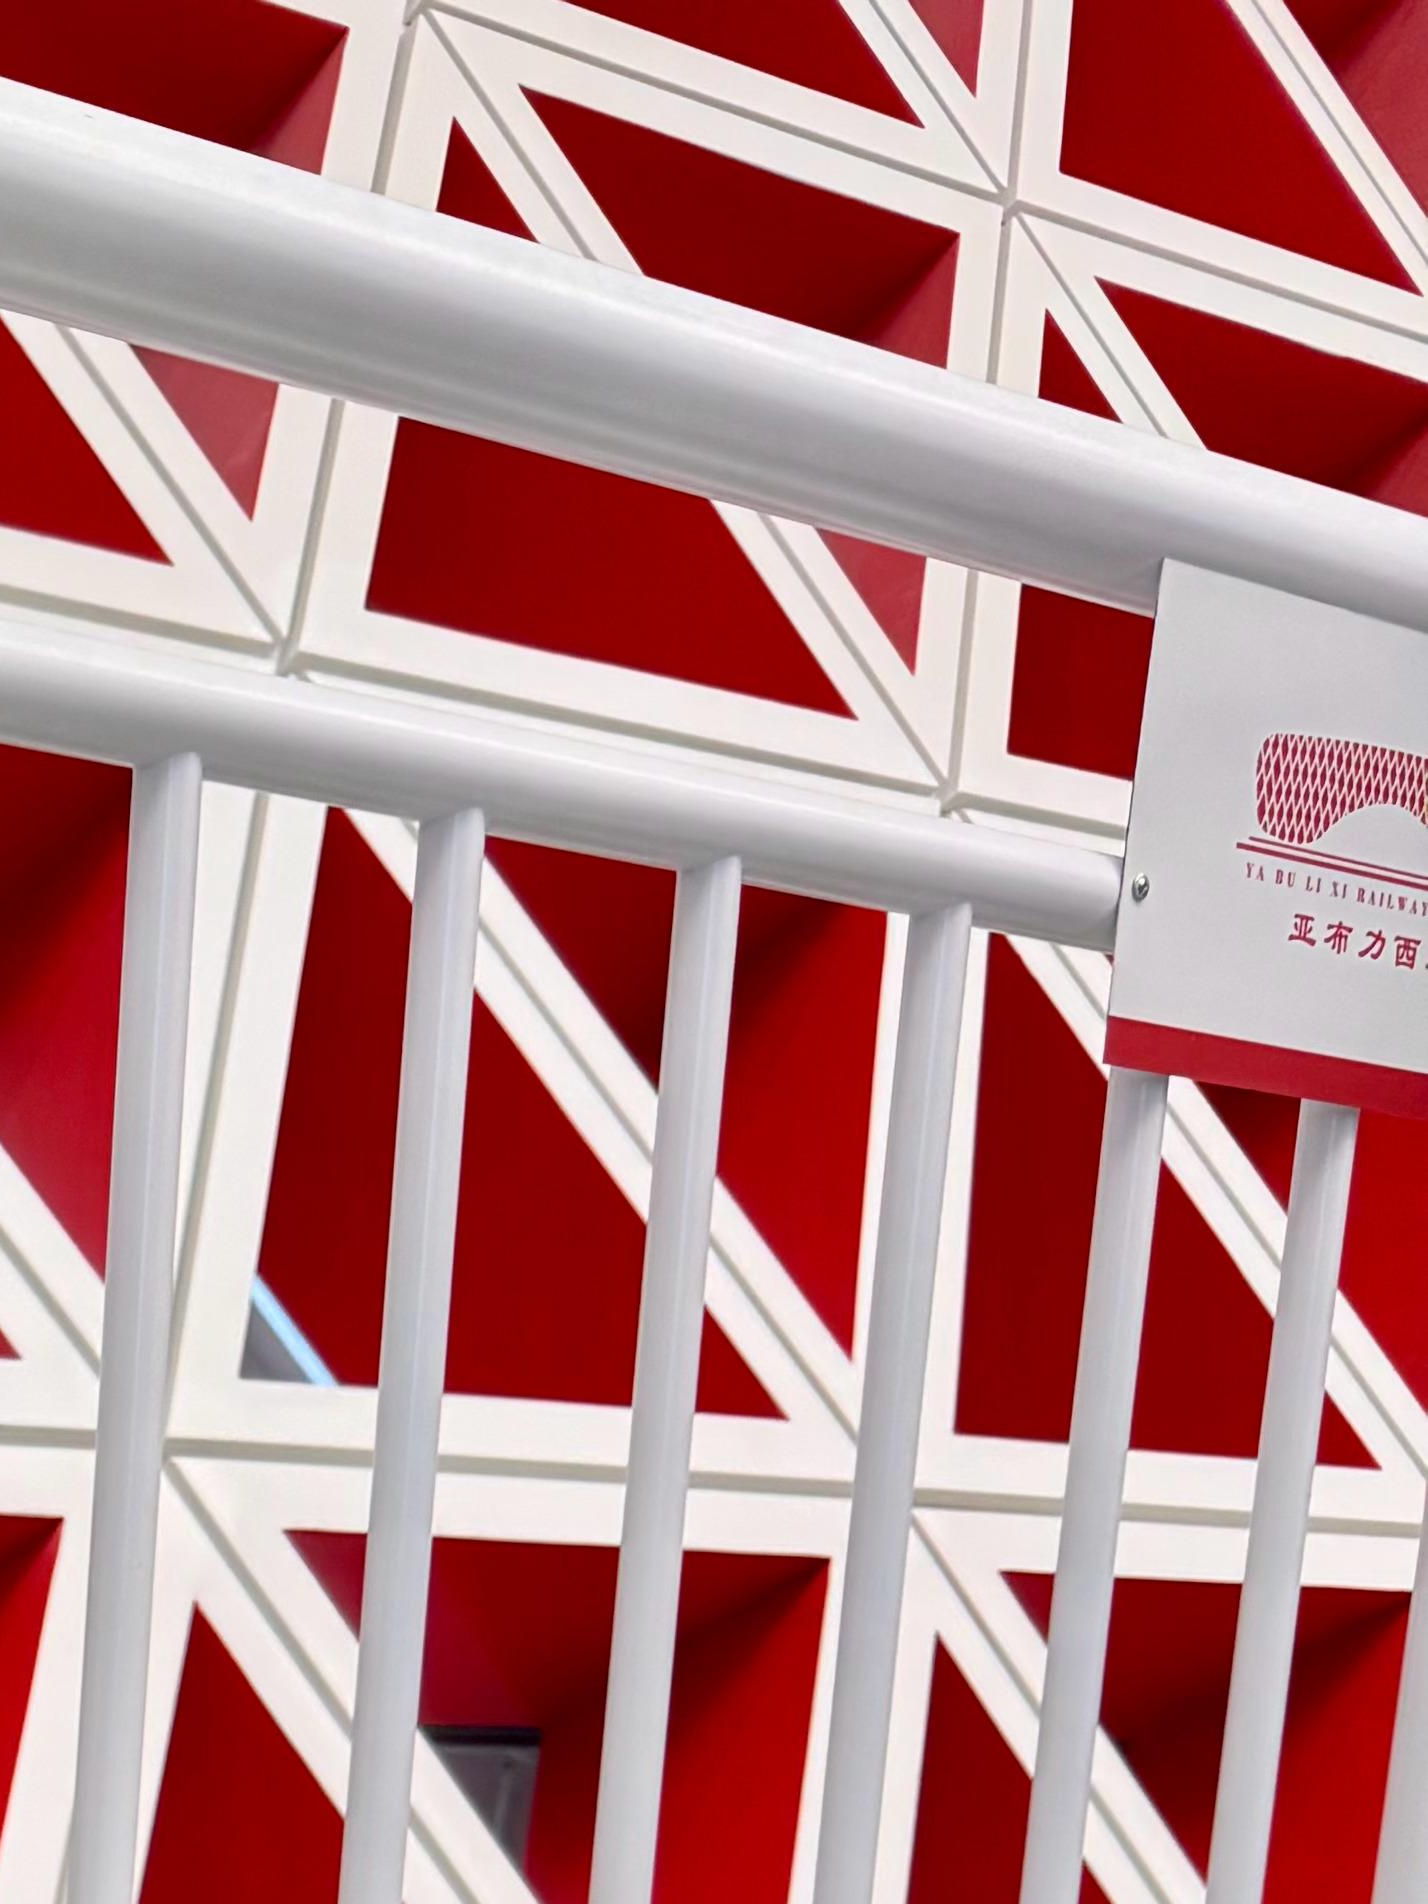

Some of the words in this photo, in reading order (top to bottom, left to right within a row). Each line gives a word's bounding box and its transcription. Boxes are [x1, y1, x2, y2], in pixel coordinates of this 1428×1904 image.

[1246, 862, 1265, 881] YA
[1275, 869, 1296, 887] BU
[1305, 876, 1322, 893] LI
[1330, 880, 1348, 899] XI
[1356, 887, 1428, 917] RAILWAY
[1288, 913, 1428, 970] 亚布力西
